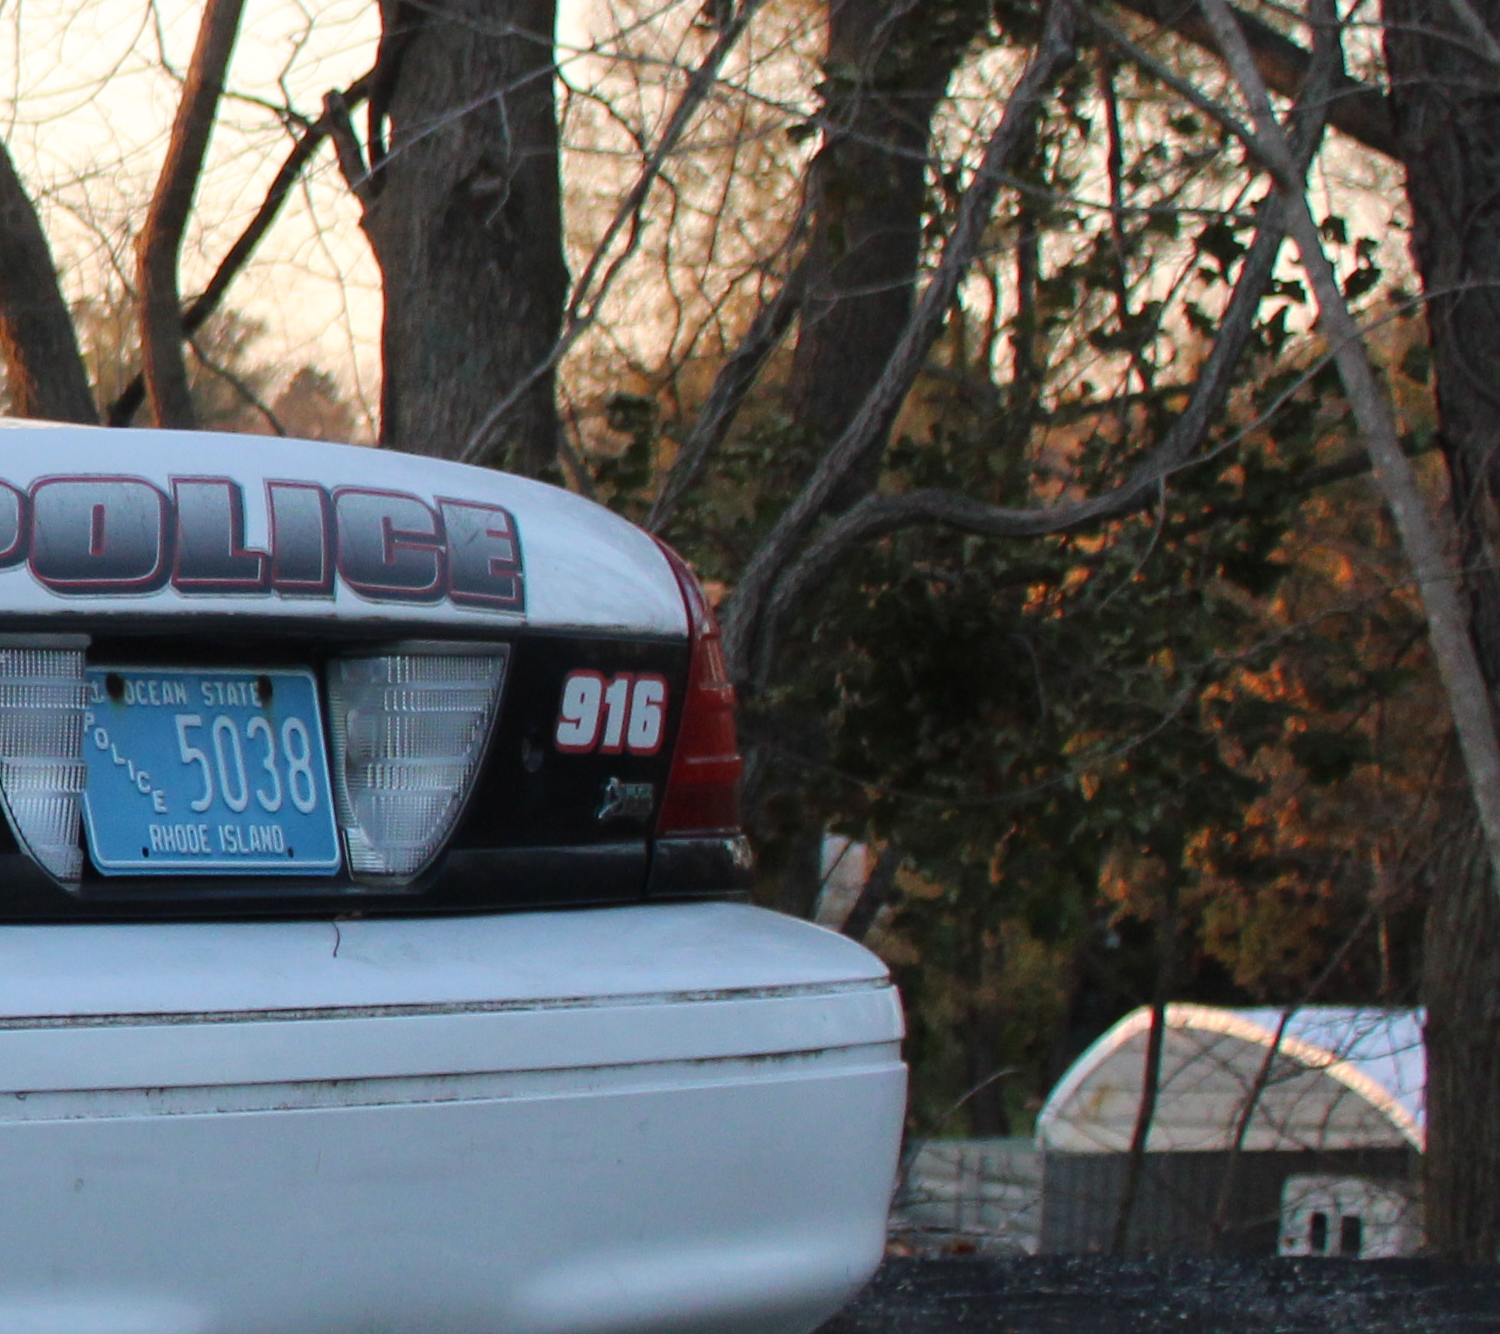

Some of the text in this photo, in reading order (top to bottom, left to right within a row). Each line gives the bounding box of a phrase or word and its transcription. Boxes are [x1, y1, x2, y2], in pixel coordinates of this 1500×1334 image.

[124, 680, 263, 708] OCEAN STATE
[556, 669, 669, 756] 916
[83, 712, 168, 814] POLICE
[175, 714, 316, 814] 5038
[150, 824, 286, 855] RHODE ISLAND
